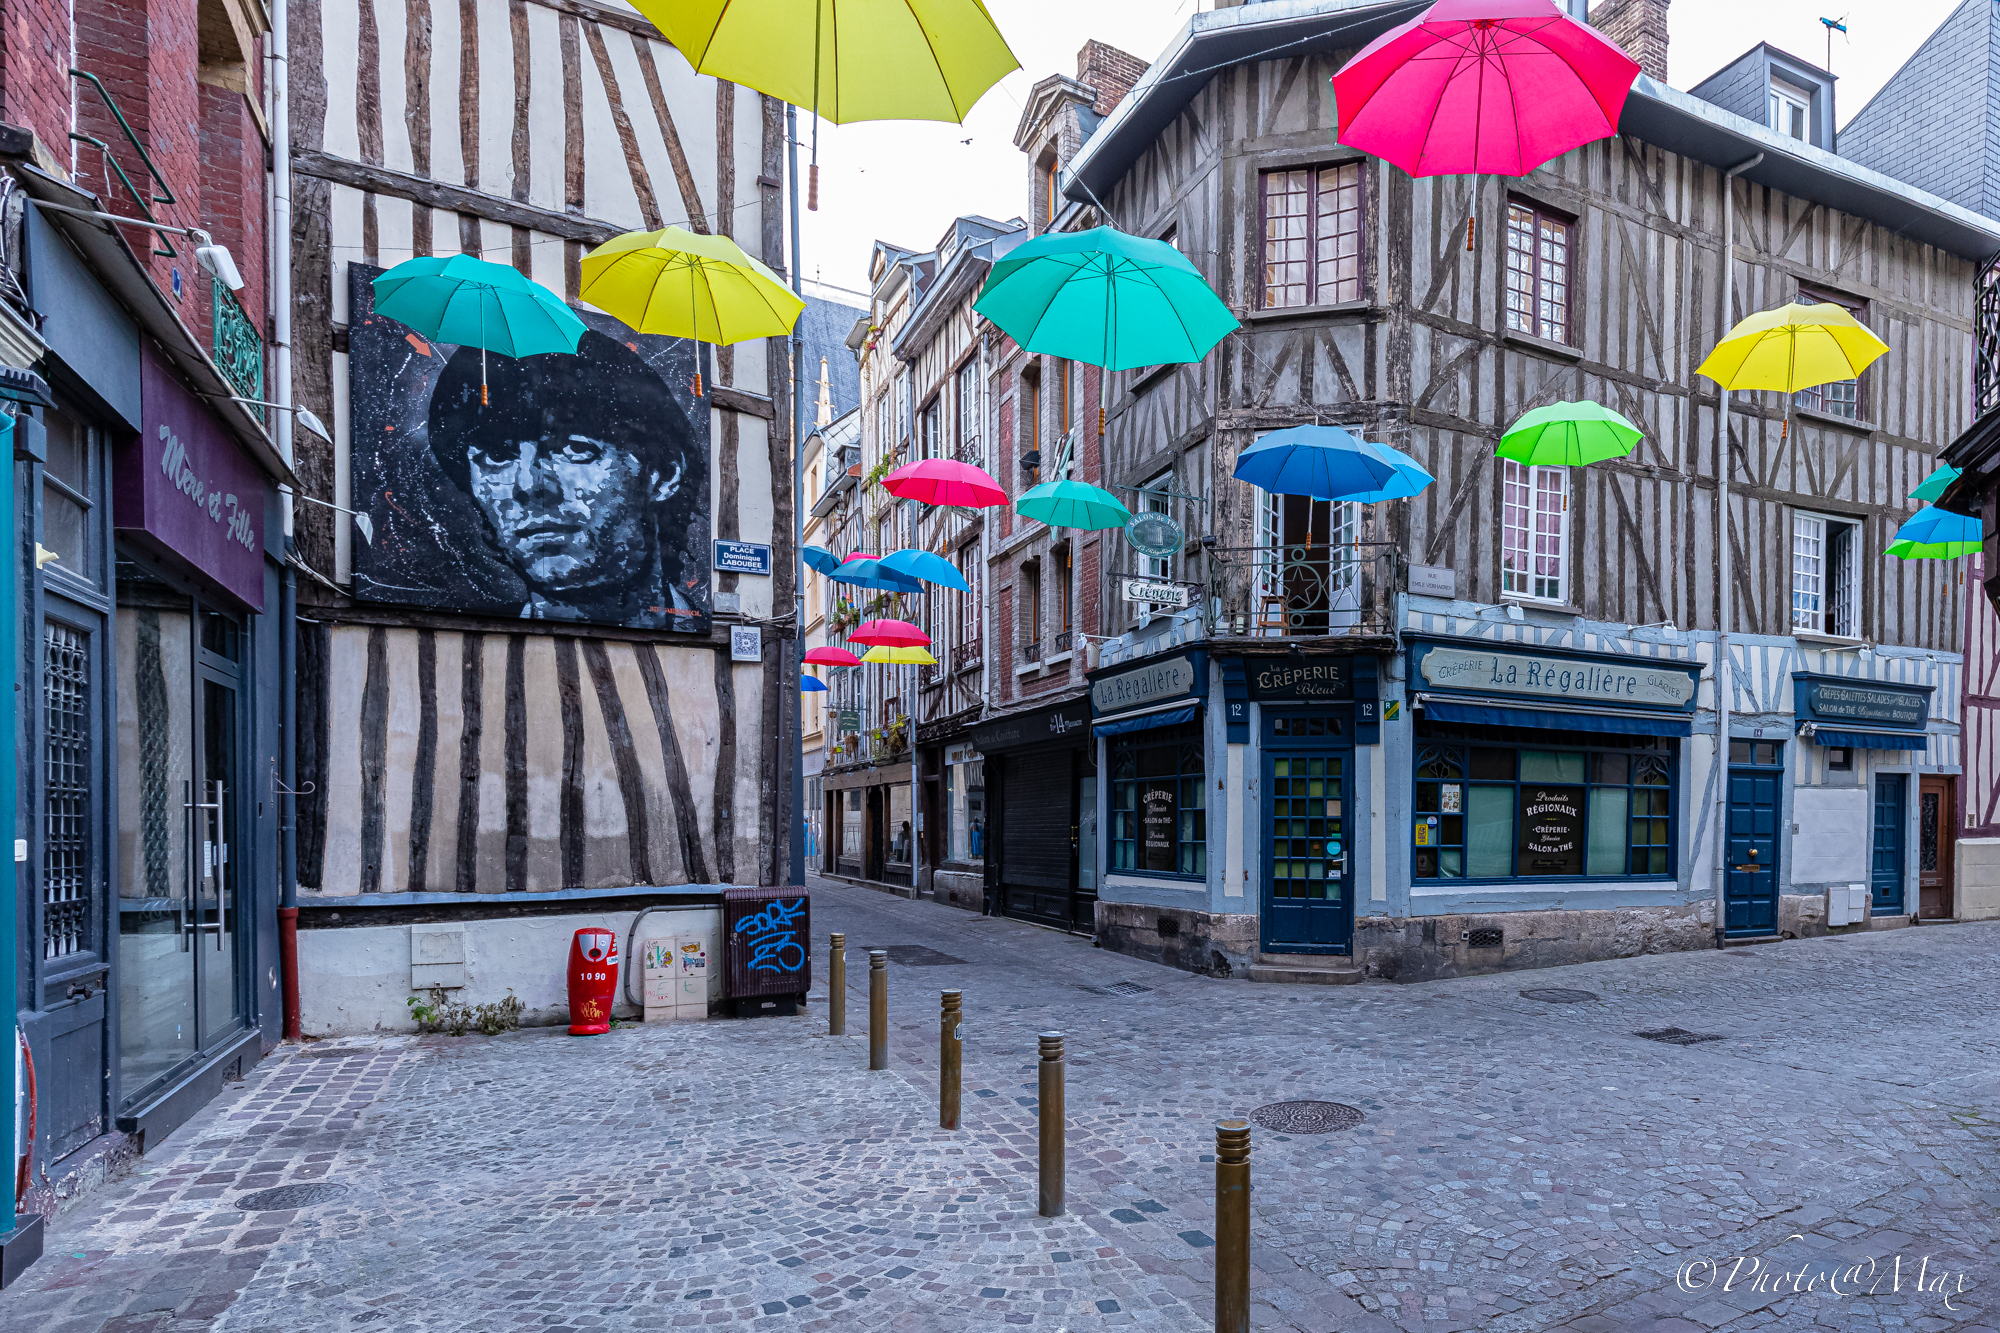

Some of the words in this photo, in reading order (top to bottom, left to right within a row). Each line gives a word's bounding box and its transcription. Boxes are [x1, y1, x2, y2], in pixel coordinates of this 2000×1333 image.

[159, 424, 204, 508] Mère
[208, 491, 221, 523] et
[226, 493, 255, 553] Fille
[1129, 513, 1154, 528] SALON
[723, 552, 761, 562] Dominique
[729, 546, 755, 555] PLACE
[1427, 572, 1437, 580] RUE
[1257, 665, 1340, 689] CRÊPERIE
[1438, 660, 1483, 679] CRÊPERIE
[1490, 656, 1517, 684] La
[1526, 661, 1637, 695] Régalière
[1647, 674, 1681, 700] GLACIER
[1100, 682, 1114, 704] La
[1116, 667, 1179, 700] Régalière
[1295, 682, 1336, 695] Bleue
[1231, 703, 1242, 716] 12
[1362, 703, 1373, 716] 12
[1819, 703, 1837, 713] SALON
[1892, 709, 1918, 720] BOUTIQUE
[1054, 713, 1066, 734] 14
[1143, 789, 1173, 803] CRÊPERIE
[1535, 790, 1569, 802] Produits
[1526, 803, 1577, 817] RÉGIONAUX
[1528, 842, 1552, 853] SALON
